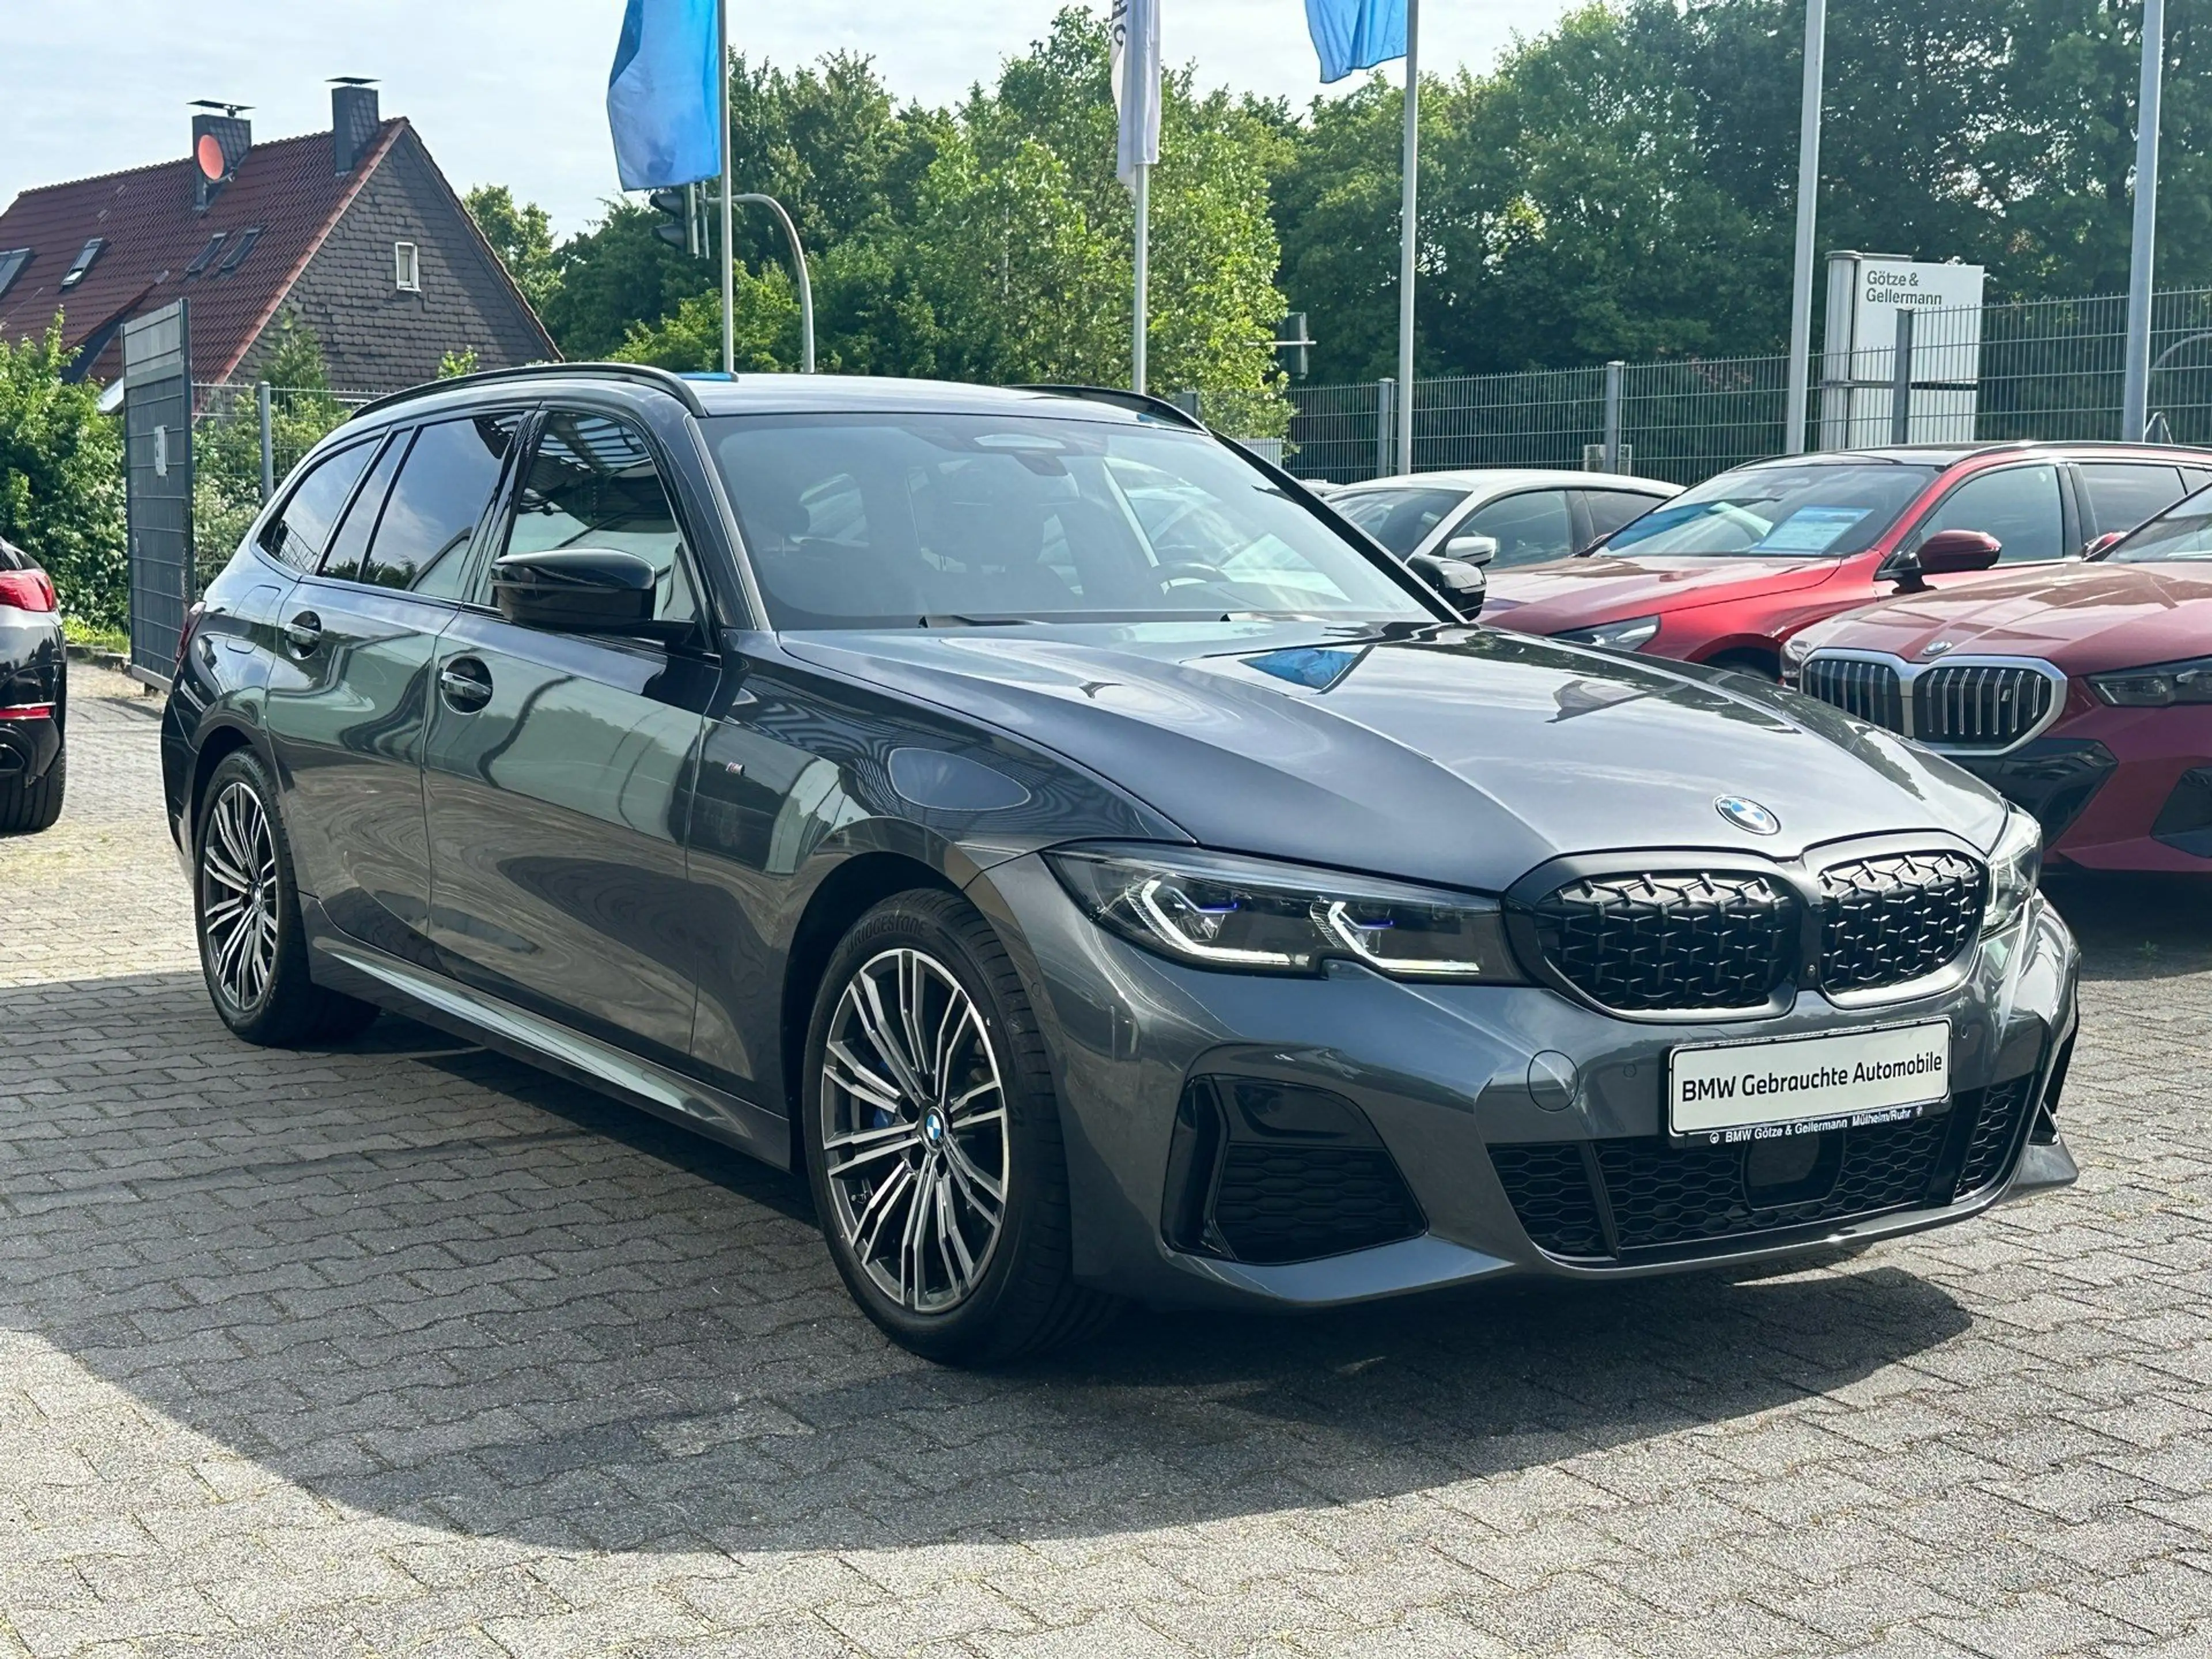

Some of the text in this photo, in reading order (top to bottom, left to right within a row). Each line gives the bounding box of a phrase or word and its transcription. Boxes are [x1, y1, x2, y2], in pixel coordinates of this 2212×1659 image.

[1867, 270, 1919, 286] Götze &
[1866, 287, 1942, 305] Gellermann
[1682, 1051, 1942, 1102] BMW Gebrauchte Automobile
[1725, 1129, 1752, 1142] BMW
[1754, 1127, 1783, 1139] Götze
[1785, 1125, 1792, 1135] &
[1795, 1119, 1847, 1135] Gellermann
